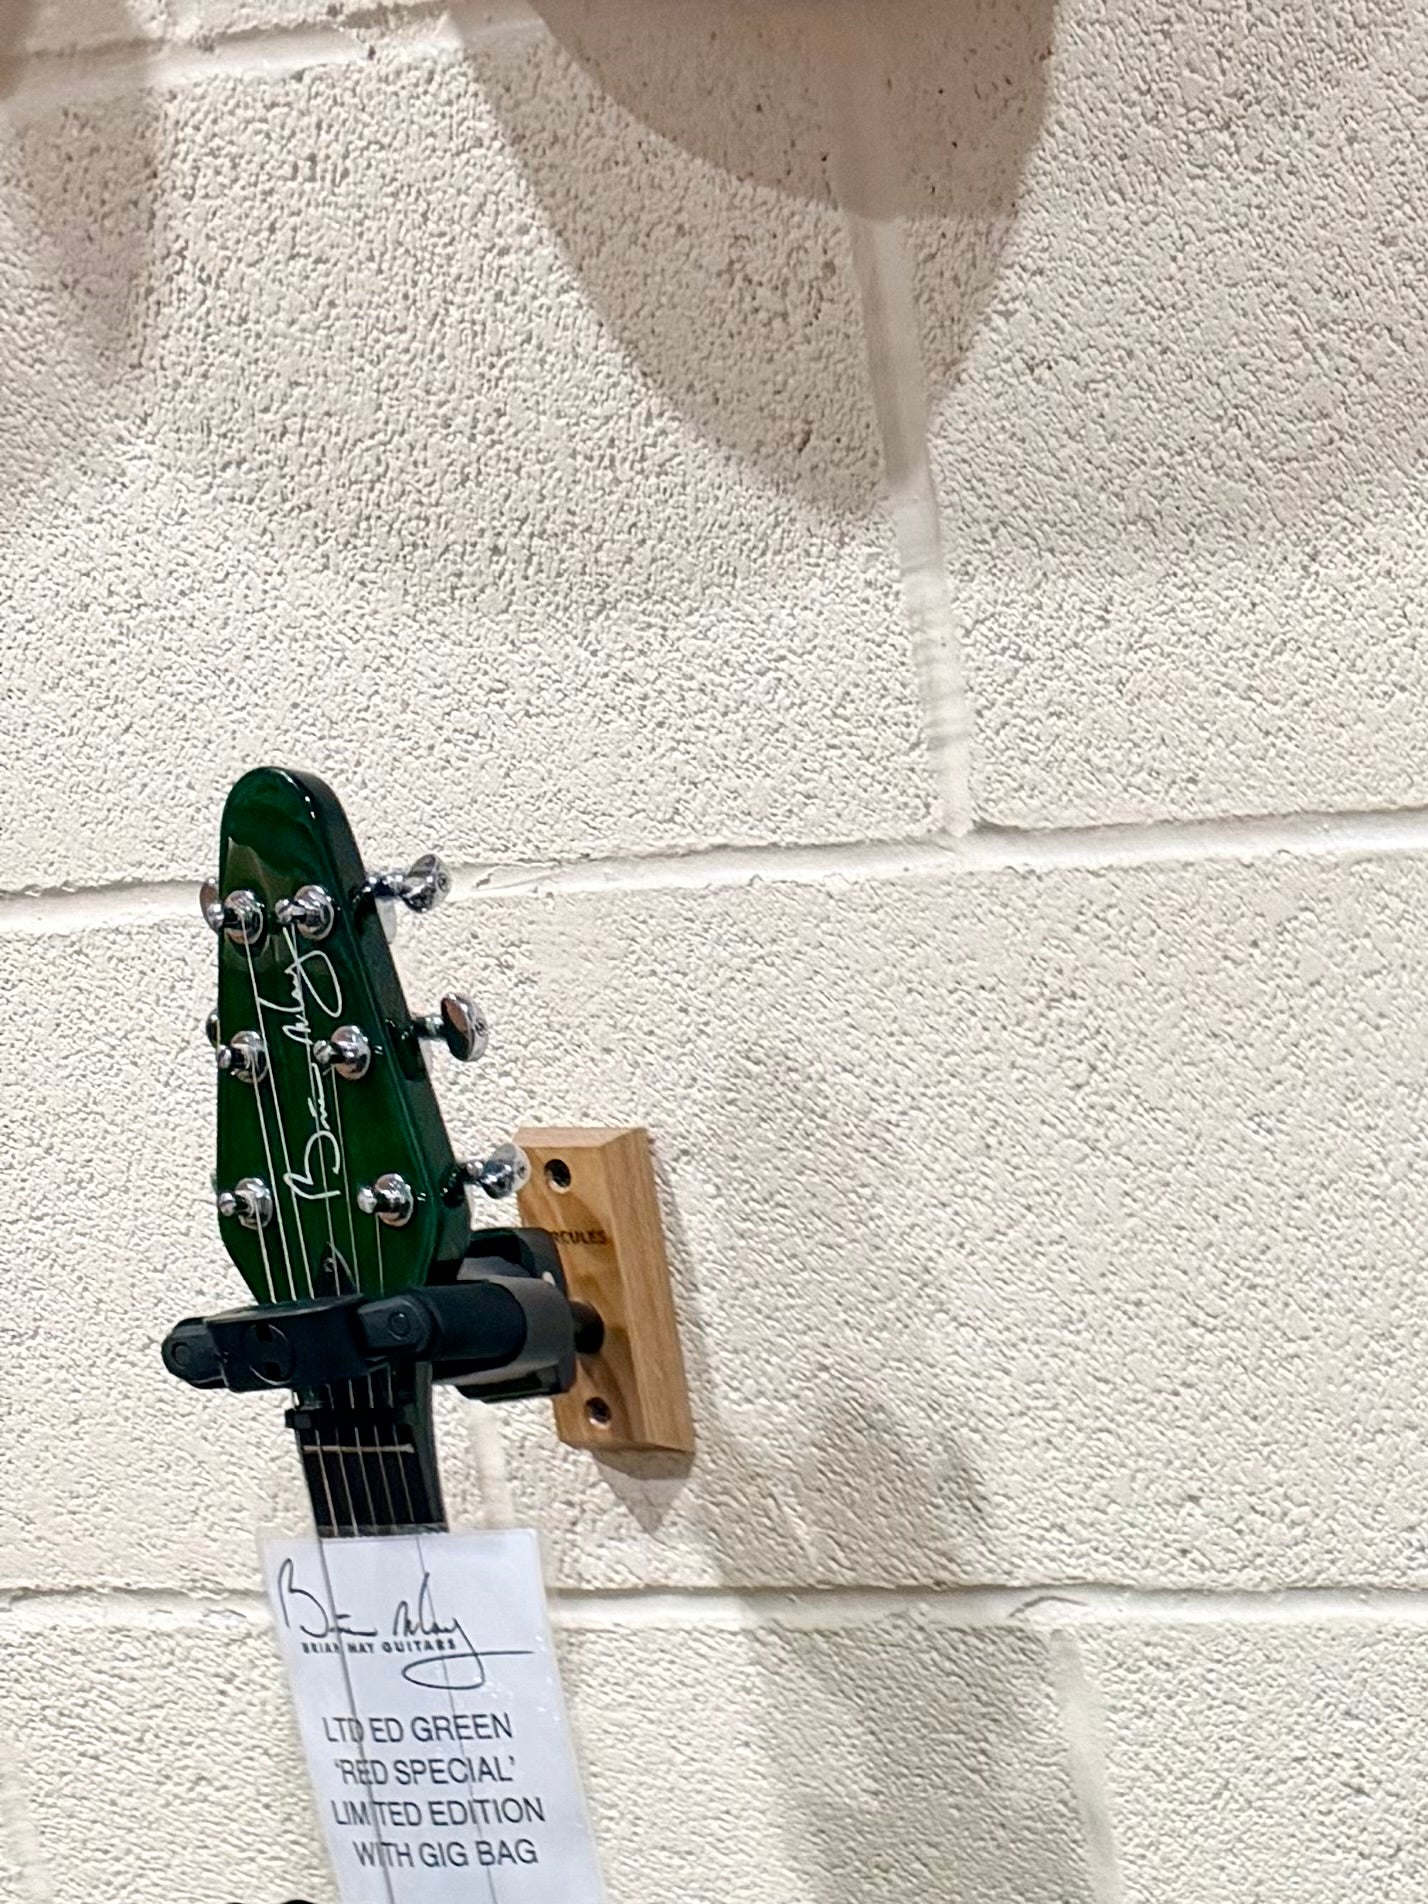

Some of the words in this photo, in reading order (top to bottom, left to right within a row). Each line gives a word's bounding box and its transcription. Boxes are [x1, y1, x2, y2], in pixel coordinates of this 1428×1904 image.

[322, 1715, 365, 1743] LTD
[370, 1716, 404, 1743] ED
[411, 1711, 514, 1742] GREEN
[428, 1796, 546, 1826] EDITION
[352, 1841, 415, 1868] WITH
[418, 1841, 469, 1868] GIG
[475, 1838, 540, 1866] BAG
